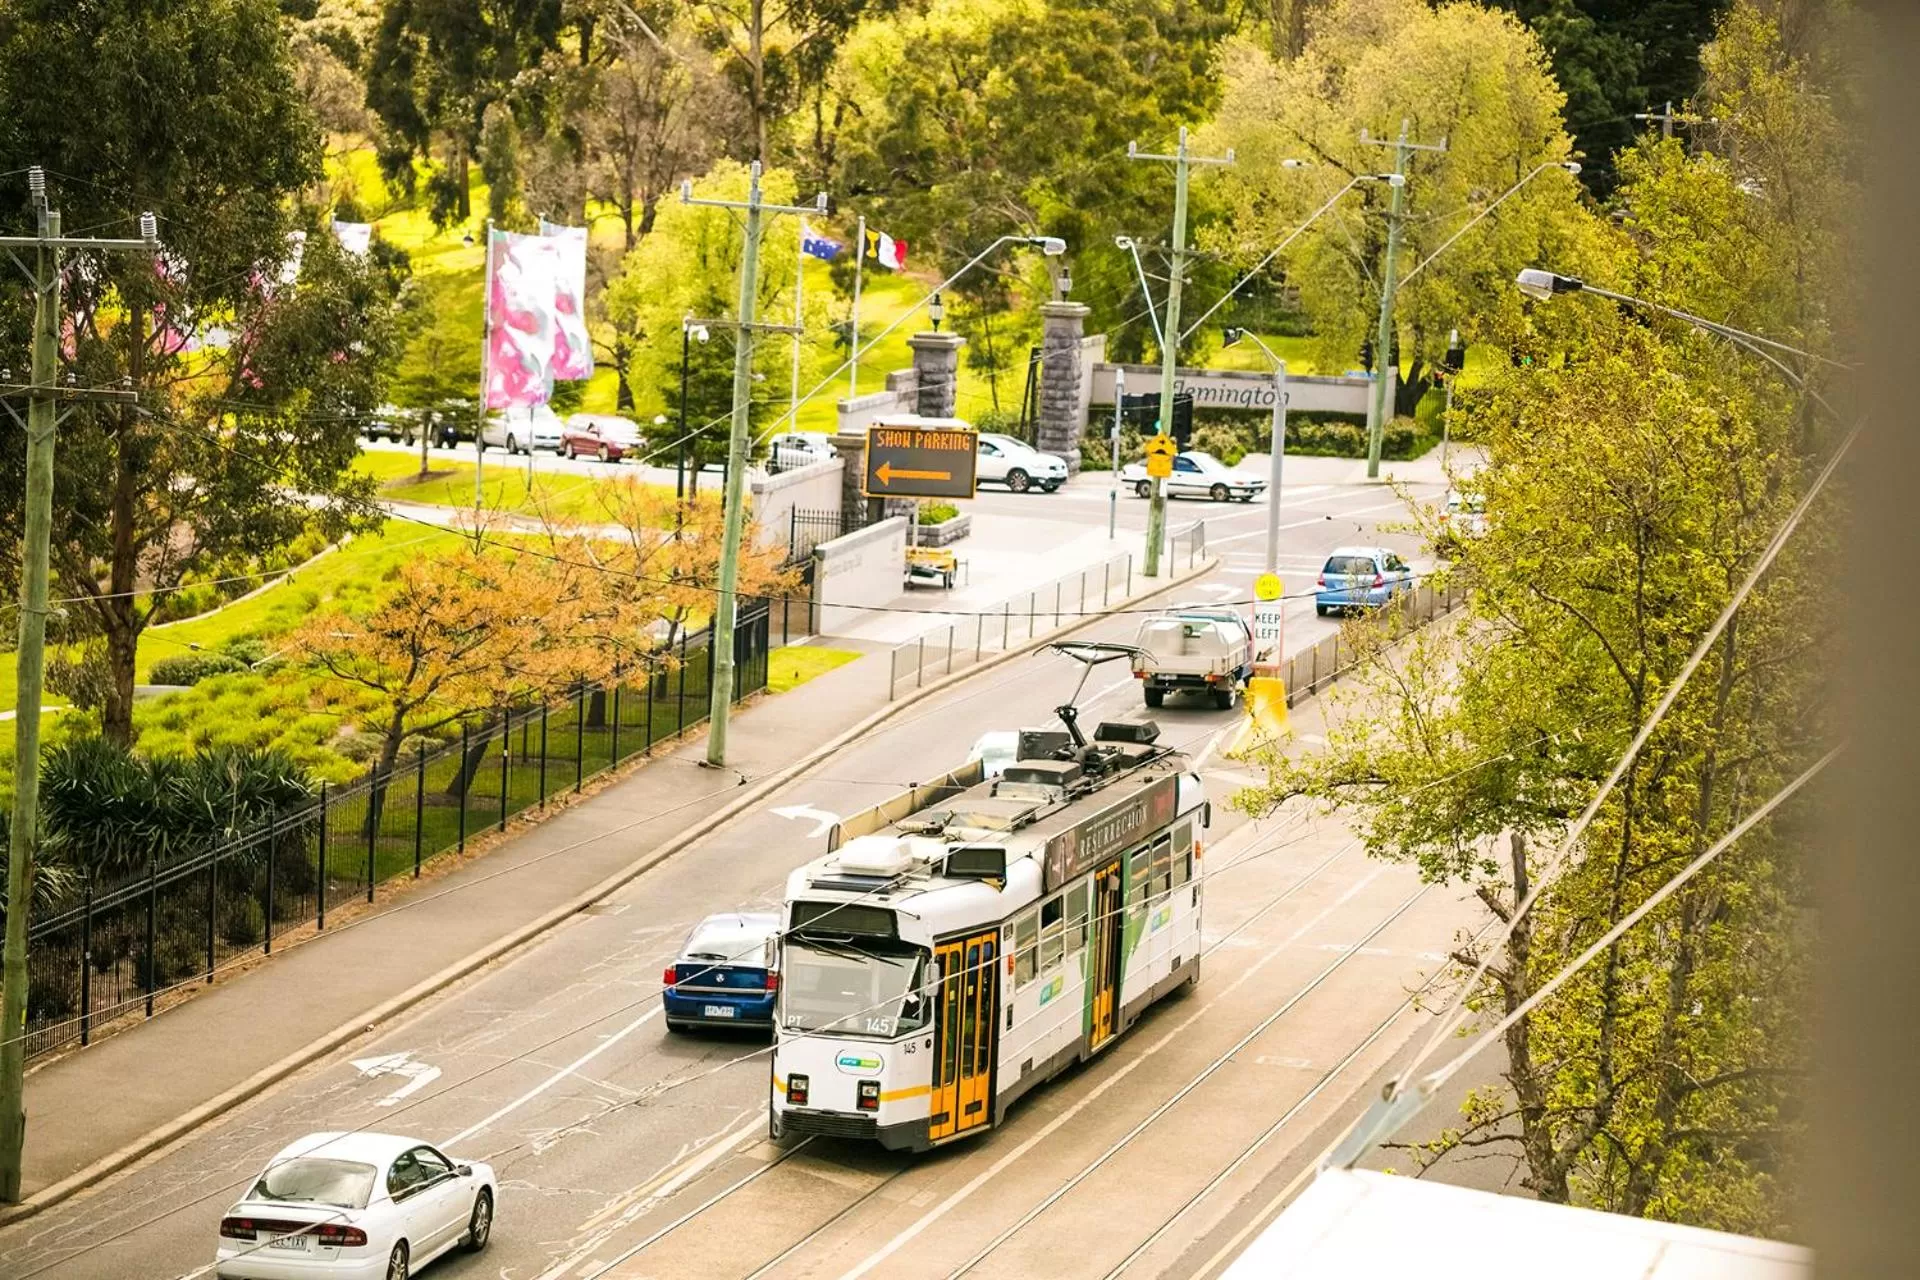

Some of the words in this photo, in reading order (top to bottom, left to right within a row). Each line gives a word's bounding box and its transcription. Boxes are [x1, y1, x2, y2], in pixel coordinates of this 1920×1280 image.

[877, 430, 911, 449] SHOW
[915, 433, 971, 451] PARKING
[1255, 612, 1281, 625] KEEP
[1255, 628, 1279, 640] LEFT
[787, 1015, 803, 1027] PT
[866, 1017, 889, 1034] 145
[903, 1042, 916, 1055] 145
